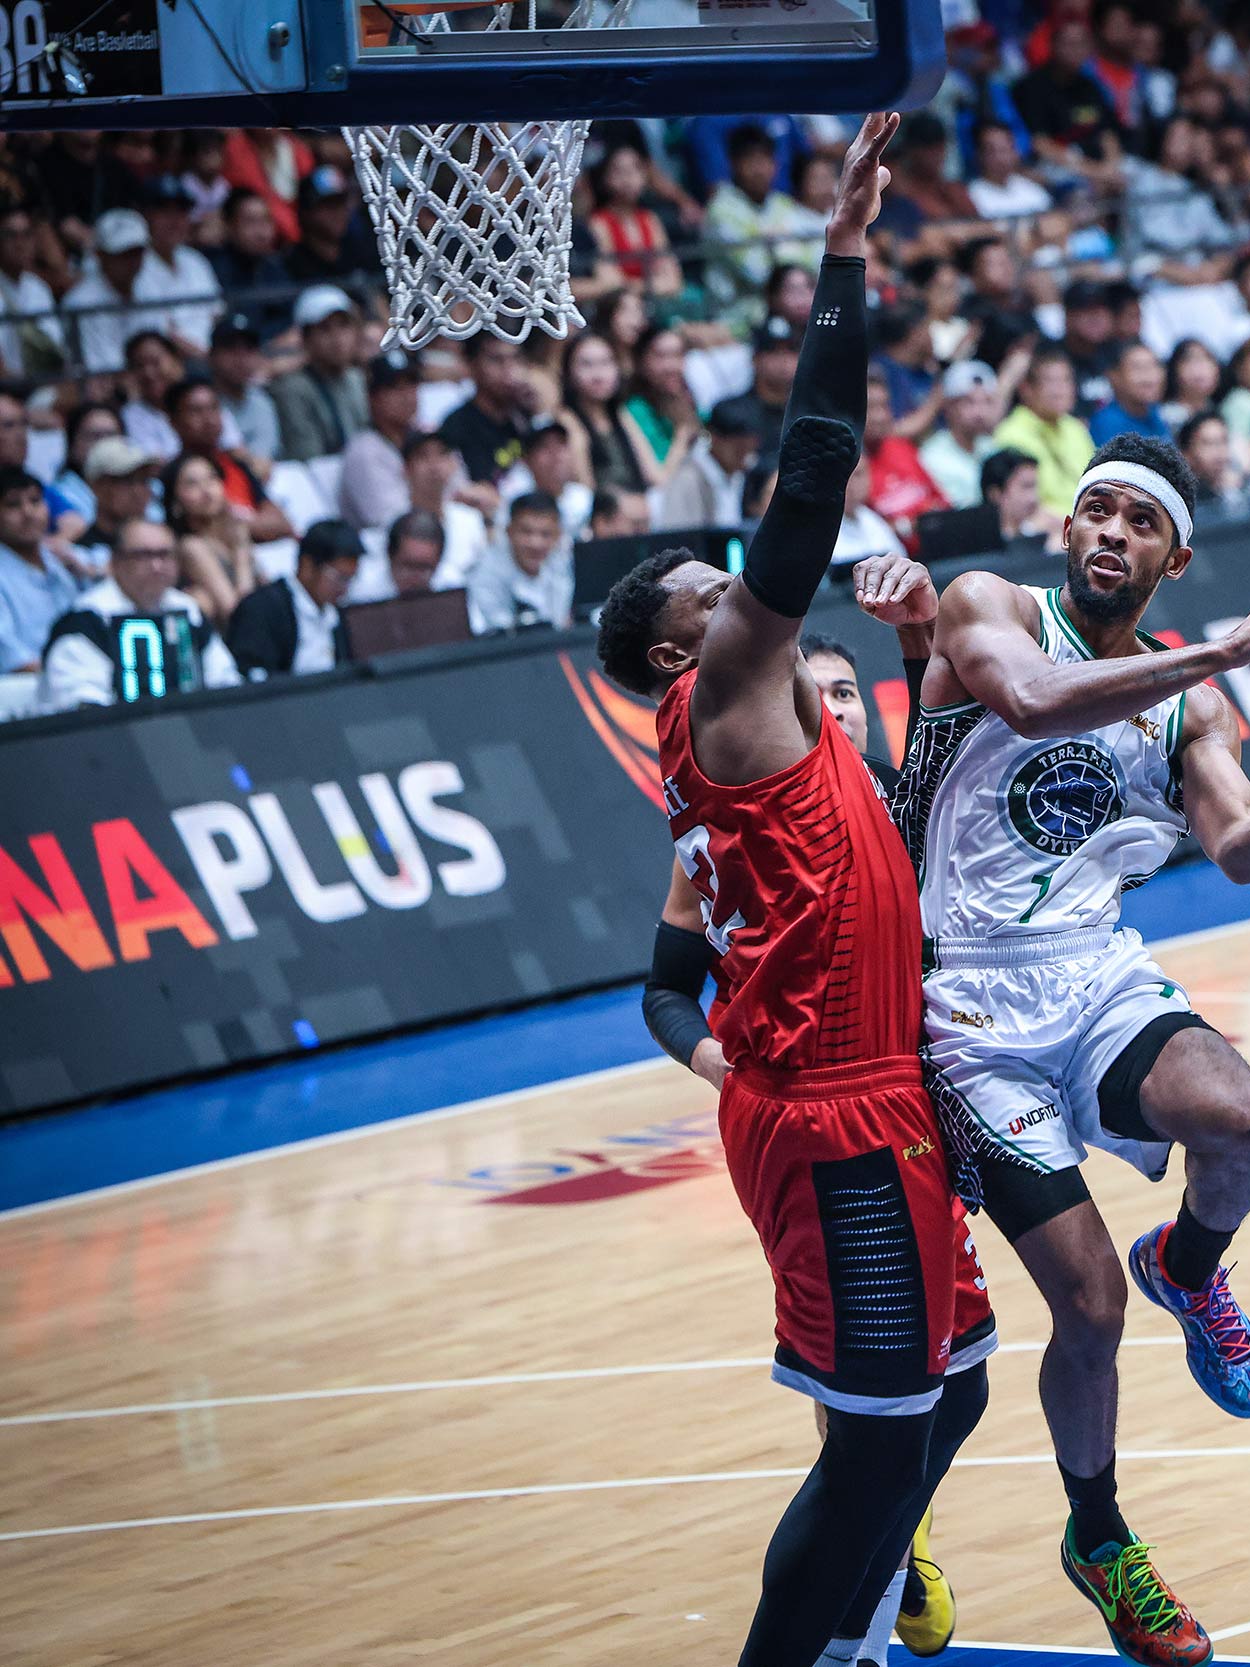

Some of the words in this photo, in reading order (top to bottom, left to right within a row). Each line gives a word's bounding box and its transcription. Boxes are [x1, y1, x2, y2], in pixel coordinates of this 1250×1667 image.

[74, 32, 96, 51] Are
[97, 30, 158, 51] Basketball
[1036, 834, 1079, 854] DYIP
[0, 760, 506, 989] NAPLUS
